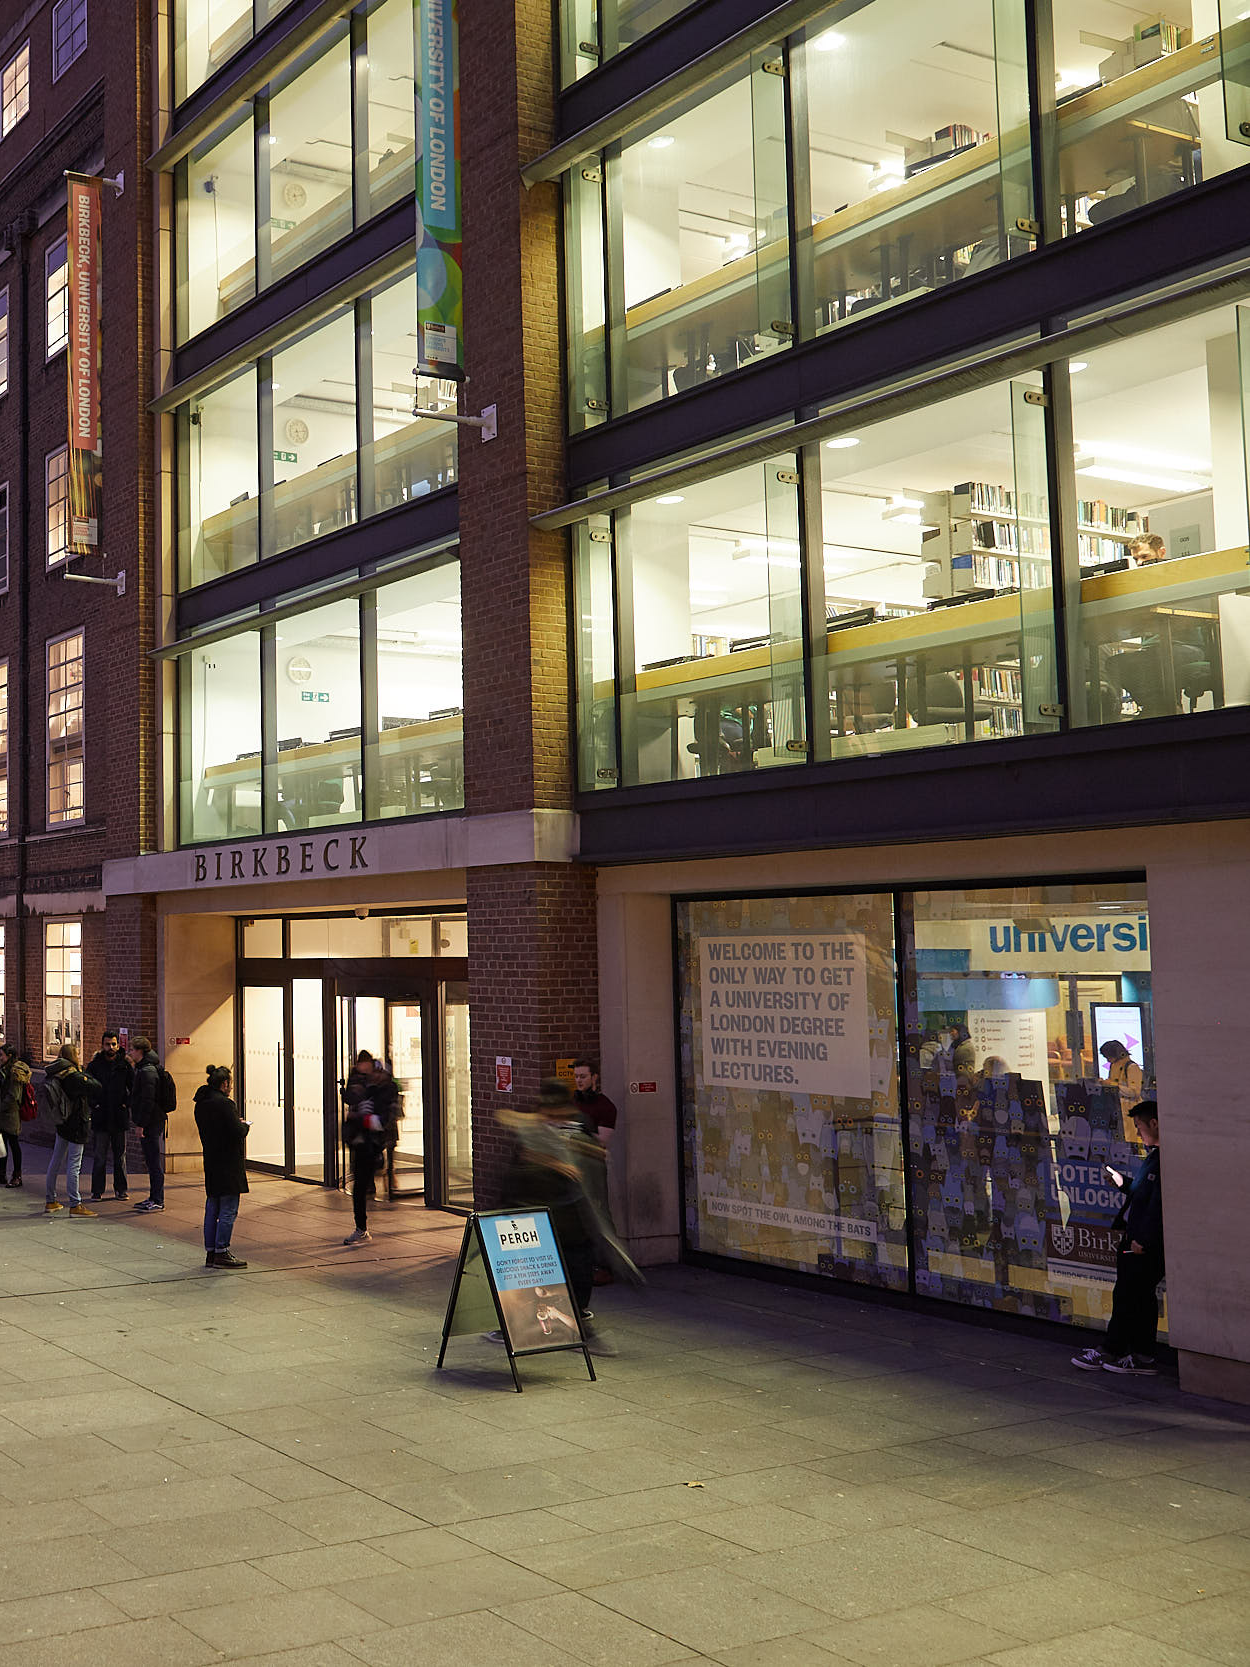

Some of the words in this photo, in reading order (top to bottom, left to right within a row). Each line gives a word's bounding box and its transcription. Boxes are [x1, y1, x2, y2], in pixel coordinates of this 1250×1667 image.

[429, 98, 445, 124] OF
[430, 126, 446, 211] LONDON
[76, 194, 90, 268] BIRKBECK,
[78, 272, 91, 356] UNIVERSITY
[78, 358, 90, 376] OF
[78, 378, 90, 438] LONDON
[195, 836, 368, 882] BIRKBECK
[708, 942, 786, 960] WELCOME
[790, 942, 814, 960] TO
[819, 942, 854, 960] THE
[709, 967, 748, 984] ONLY
[753, 967, 786, 984] WAY
[793, 967, 816, 985] TO
[820, 968, 854, 986] GET
[710, 990, 720, 1008] A
[725, 990, 822, 1010] UNIVERSITY
[828, 992, 850, 1011] OF
[710, 1014, 774, 1034] LONDON
[780, 1016, 846, 1036] DEGREE
[711, 1037, 752, 1056] WITH
[756, 1040, 828, 1061] EVENING
[712, 1061, 798, 1084] LECTURES.
[1050, 1184, 1127, 1209] UNLOCK
[712, 1202, 730, 1212] NOW
[732, 1204, 753, 1216] SPOT
[754, 1208, 772, 1220] THE
[772, 1211, 792, 1224] OWL
[794, 1214, 826, 1228] AMONG
[828, 1220, 845, 1232] THE
[847, 1222, 871, 1236] BATS
[500, 1230, 538, 1245] PERCH
